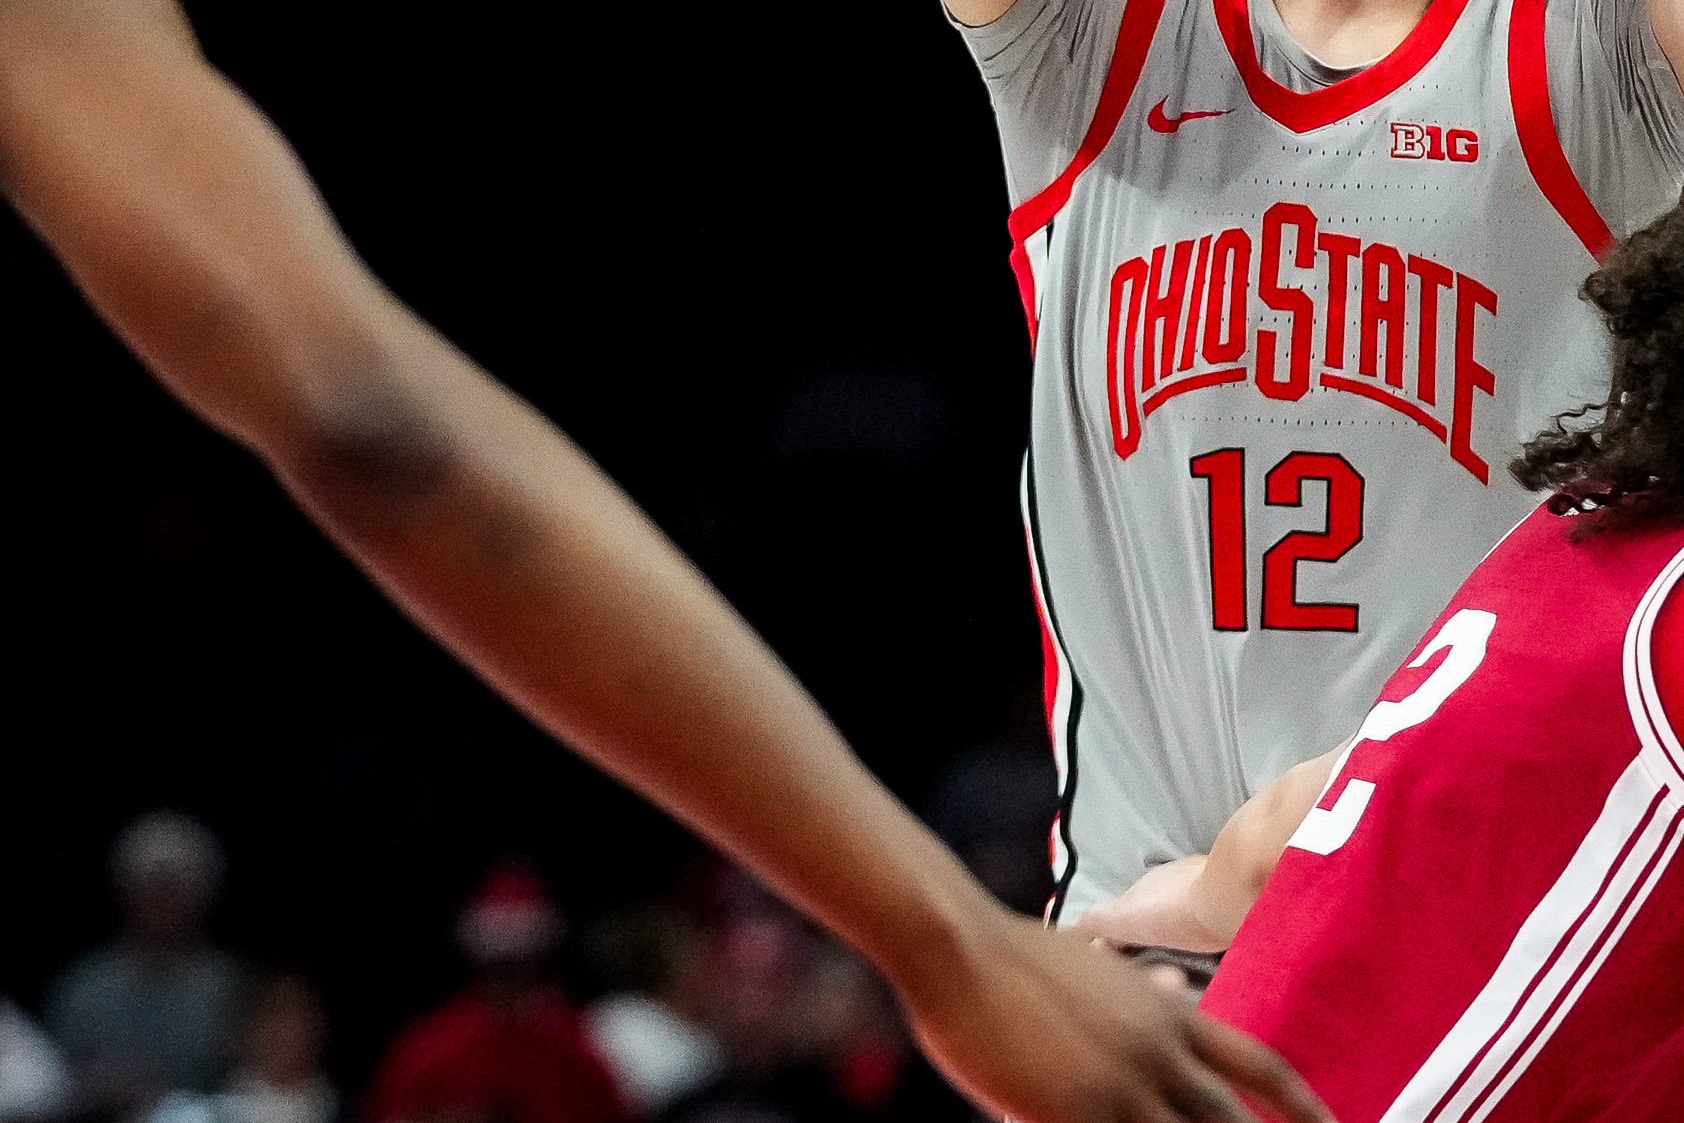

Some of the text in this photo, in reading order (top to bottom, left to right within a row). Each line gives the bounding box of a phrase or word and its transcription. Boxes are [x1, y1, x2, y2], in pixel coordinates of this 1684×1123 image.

[1105, 202, 1499, 487] OHIO STATE
[1189, 446, 1366, 634] 12
[1286, 608, 1498, 857] 2
